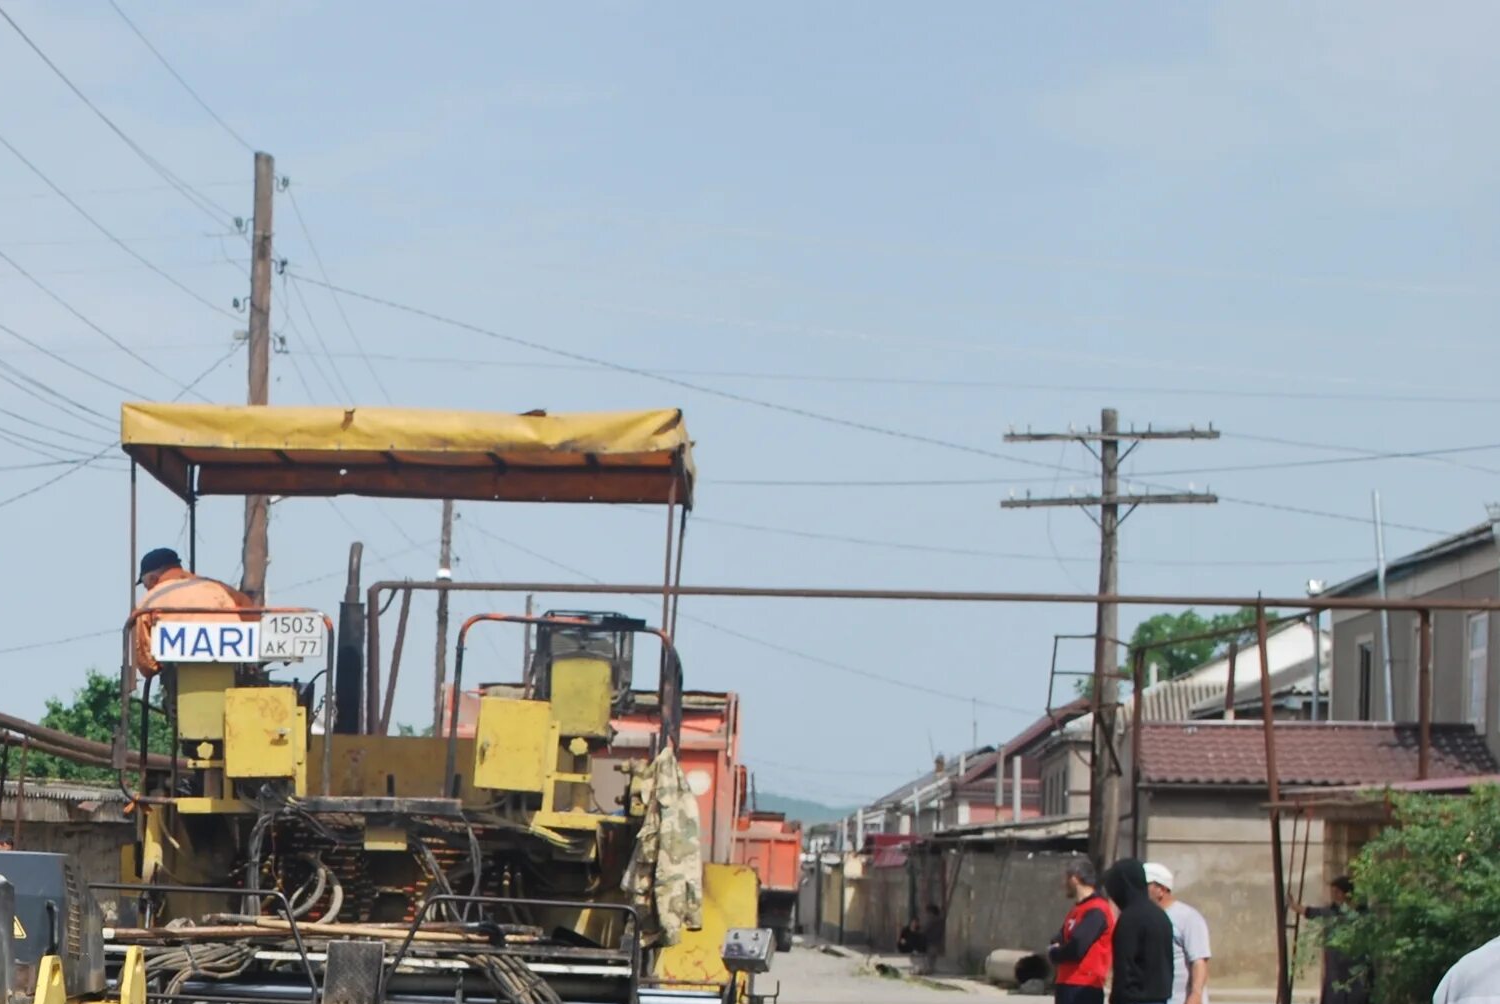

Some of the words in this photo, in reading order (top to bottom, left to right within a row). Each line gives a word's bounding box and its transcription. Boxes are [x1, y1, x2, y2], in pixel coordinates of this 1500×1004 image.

[270, 616, 315, 634] 1503
[160, 627, 253, 657] MARI
[265, 641, 287, 654] AK
[299, 641, 317, 654] 77
